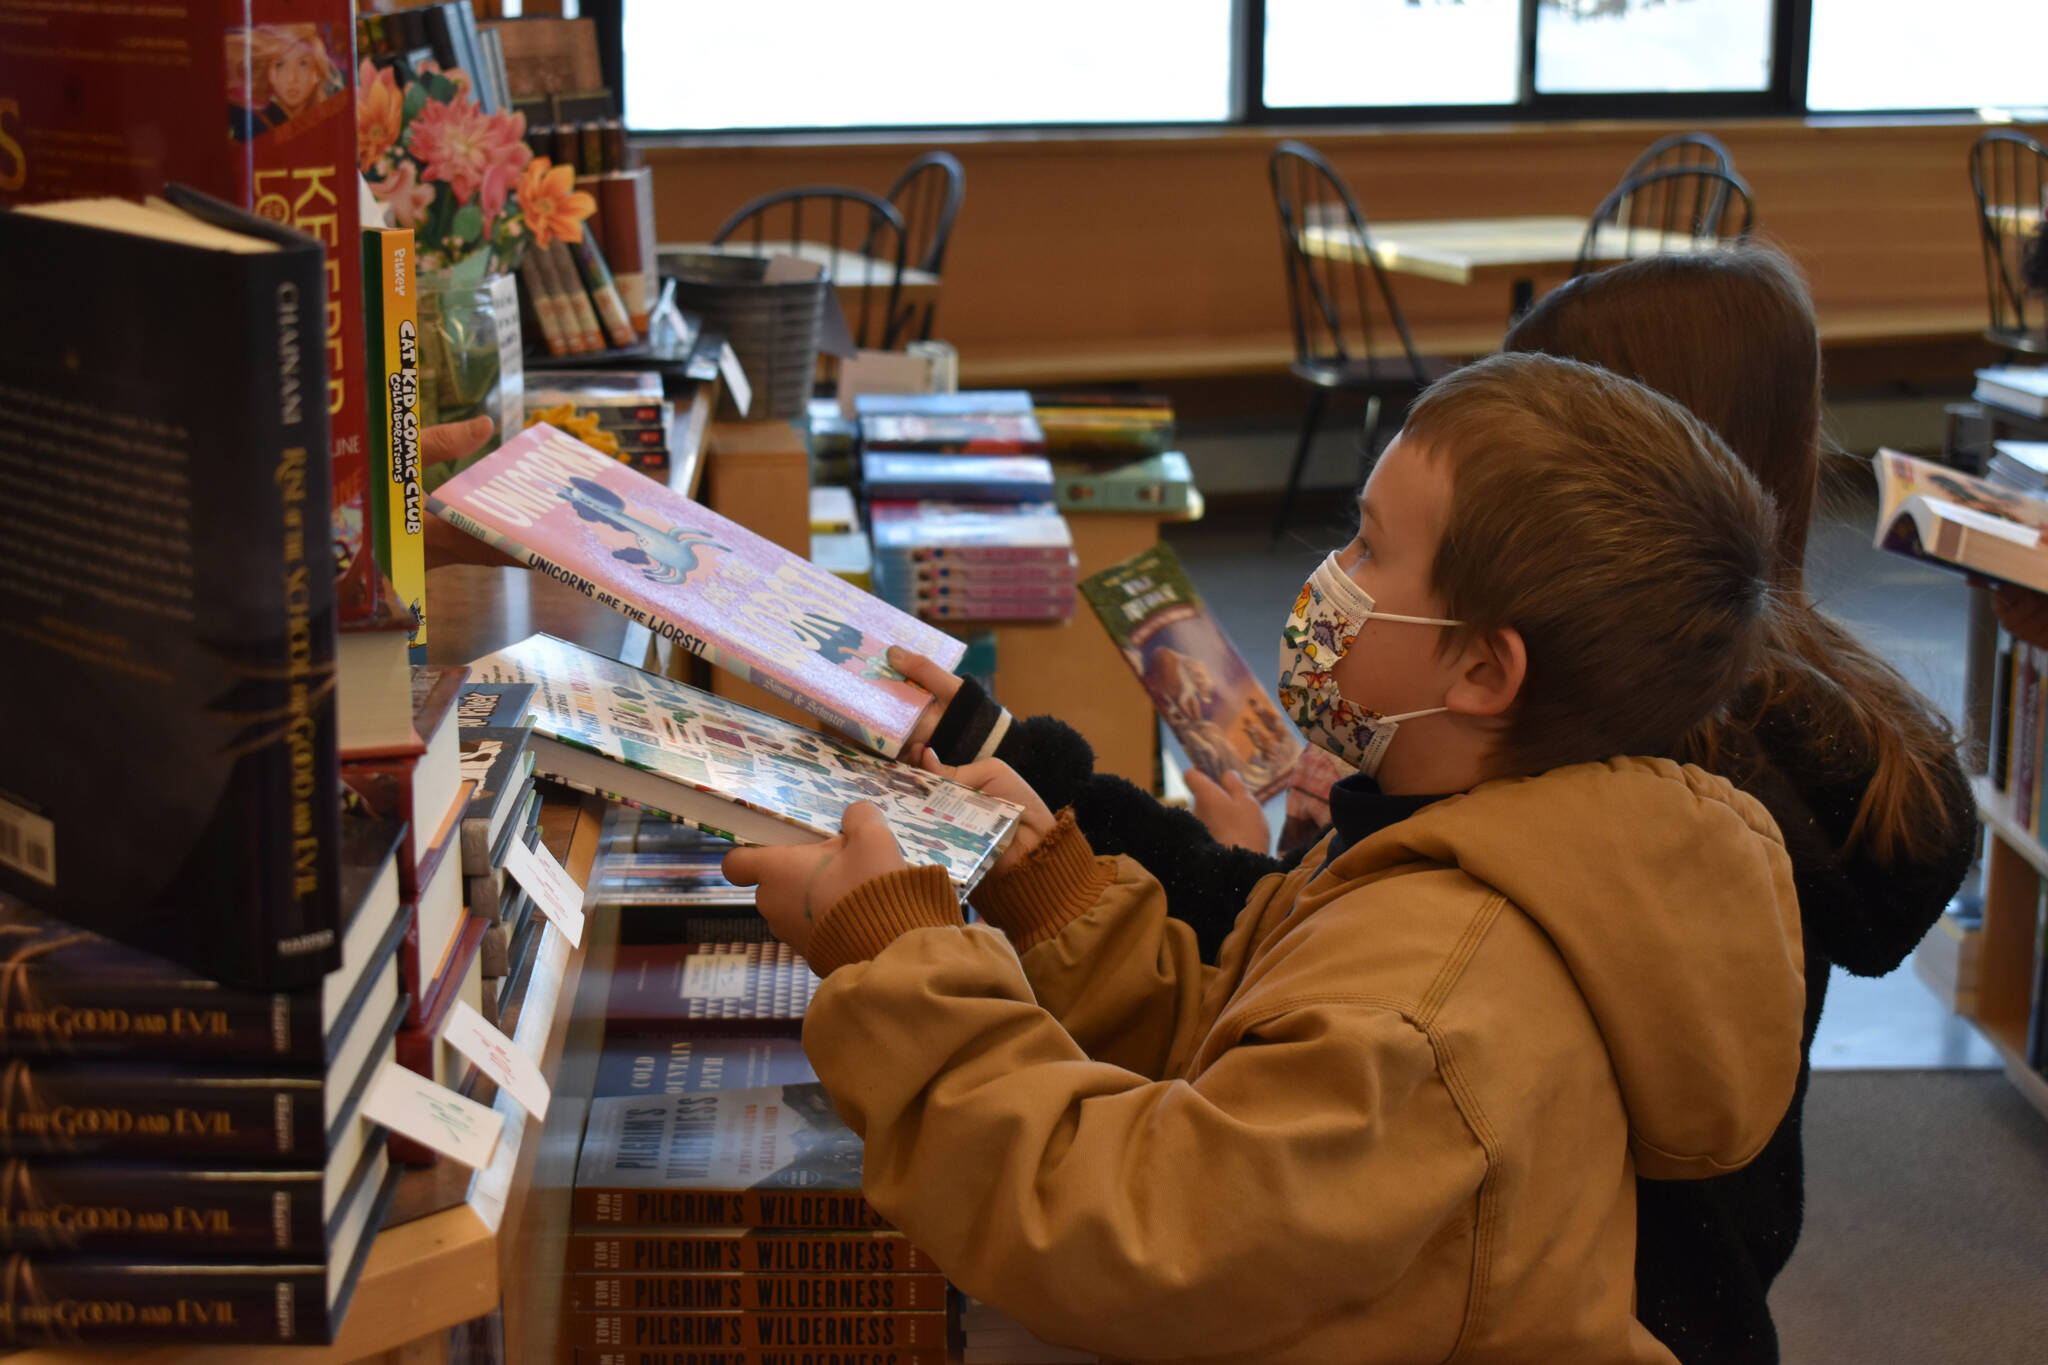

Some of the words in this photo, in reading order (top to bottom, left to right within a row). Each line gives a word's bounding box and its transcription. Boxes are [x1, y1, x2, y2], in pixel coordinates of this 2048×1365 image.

[399, 320, 416, 363] CAT
[463, 432, 614, 528] UNICORNS
[405, 480, 421, 534] CLUB
[528, 552, 596, 598] UNICORNS
[597, 591, 621, 611] ARE
[623, 603, 647, 623] THE
[648, 615, 708, 657] WORST!
[286, 564, 312, 678] SCHOOL
[294, 836, 318, 899] EVIL
[50, 1004, 130, 1035] GOOD
[171, 1007, 231, 1036] EVIL
[630, 1056, 656, 1088] COLD
[664, 1042, 694, 1094] OUNTAIN
[699, 1057, 724, 1088] PATH
[51, 1105, 134, 1135] GOOD
[174, 1108, 235, 1136] EVIL
[615, 1108, 667, 1169] PILGRIM'S
[665, 1096, 719, 1179] WILDERNESS
[53, 1203, 133, 1233] GOOD
[173, 1206, 231, 1232] EVIL
[597, 1193, 611, 1221] TOM
[637, 1193, 744, 1225] PILGRIM'S
[594, 1241, 609, 1268] TOM
[635, 1240, 741, 1269] PILGRIM'S
[757, 1241, 895, 1270] WILDERNESS
[595, 1279, 609, 1307] TOM
[636, 1279, 742, 1308] PILGRIM'S
[757, 1279, 895, 1308] WILDERNESS
[54, 1299, 137, 1328] GOOD
[176, 1300, 237, 1325] EVIL
[596, 1317, 610, 1345] TOM
[636, 1316, 743, 1345] PILGRIM'S
[757, 1317, 895, 1346] WILDERNESS
